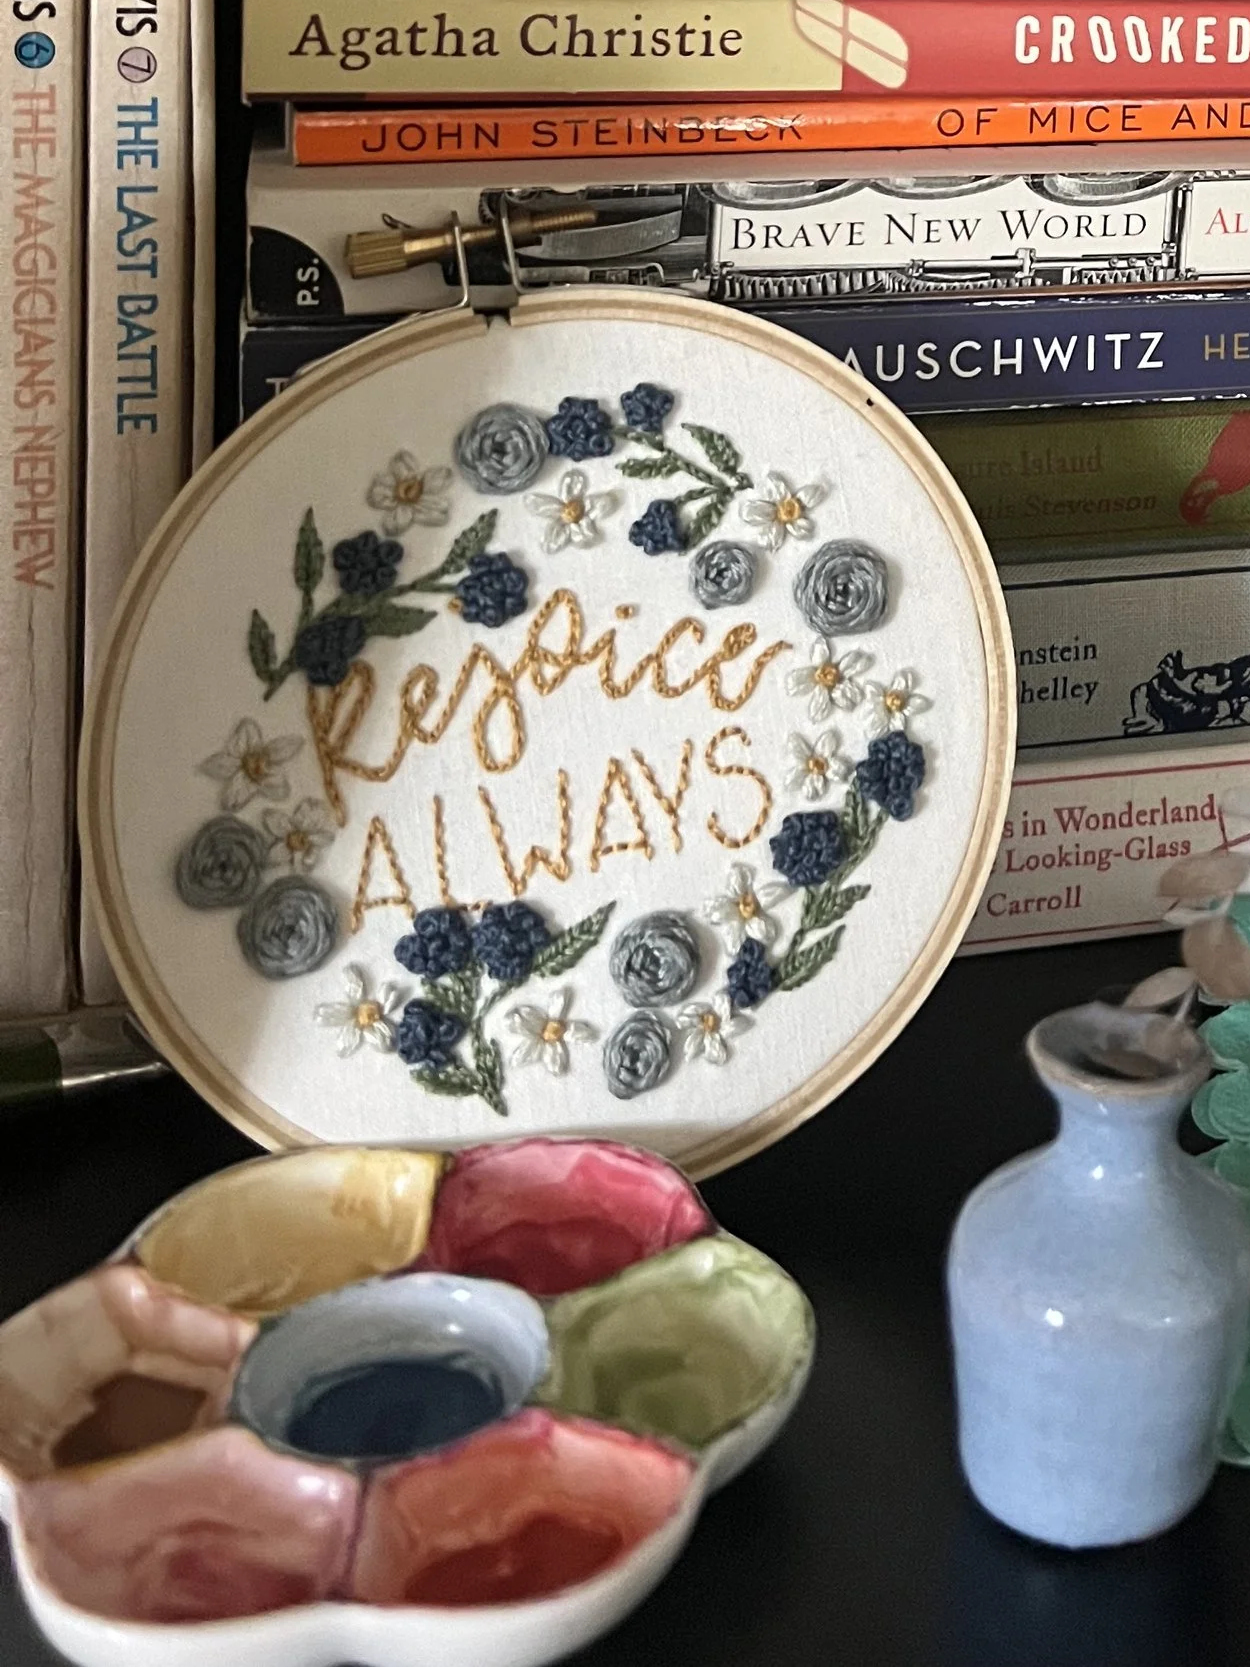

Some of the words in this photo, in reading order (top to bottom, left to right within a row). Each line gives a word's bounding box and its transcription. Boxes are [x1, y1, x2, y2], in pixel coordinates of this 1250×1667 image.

[288, 13, 500, 71] Agatha
[519, 12, 744, 58] Christie
[13, 84, 57, 159] THE
[116, 97, 159, 170] THE
[361, 121, 502, 153] JOHN
[531, 113, 805, 148] STEINBECK
[937, 107, 998, 137] OF
[1028, 103, 1143, 135] MICE
[116, 186, 159, 278] LAST
[12, 172, 58, 412] MAGICIANS
[297, 258, 320, 306] P.S.
[116, 295, 159, 435] BATTLE
[12, 422, 57, 591] NEPHEW
[308, 589, 794, 827] Rejoice
[351, 726, 776, 935] ALWAYS
[1022, 811, 1046, 836] in
[1054, 794, 1217, 834] Wonderland
[1006, 836, 1191, 872] Looking-Glass
[987, 886, 1081, 917] Carroll
